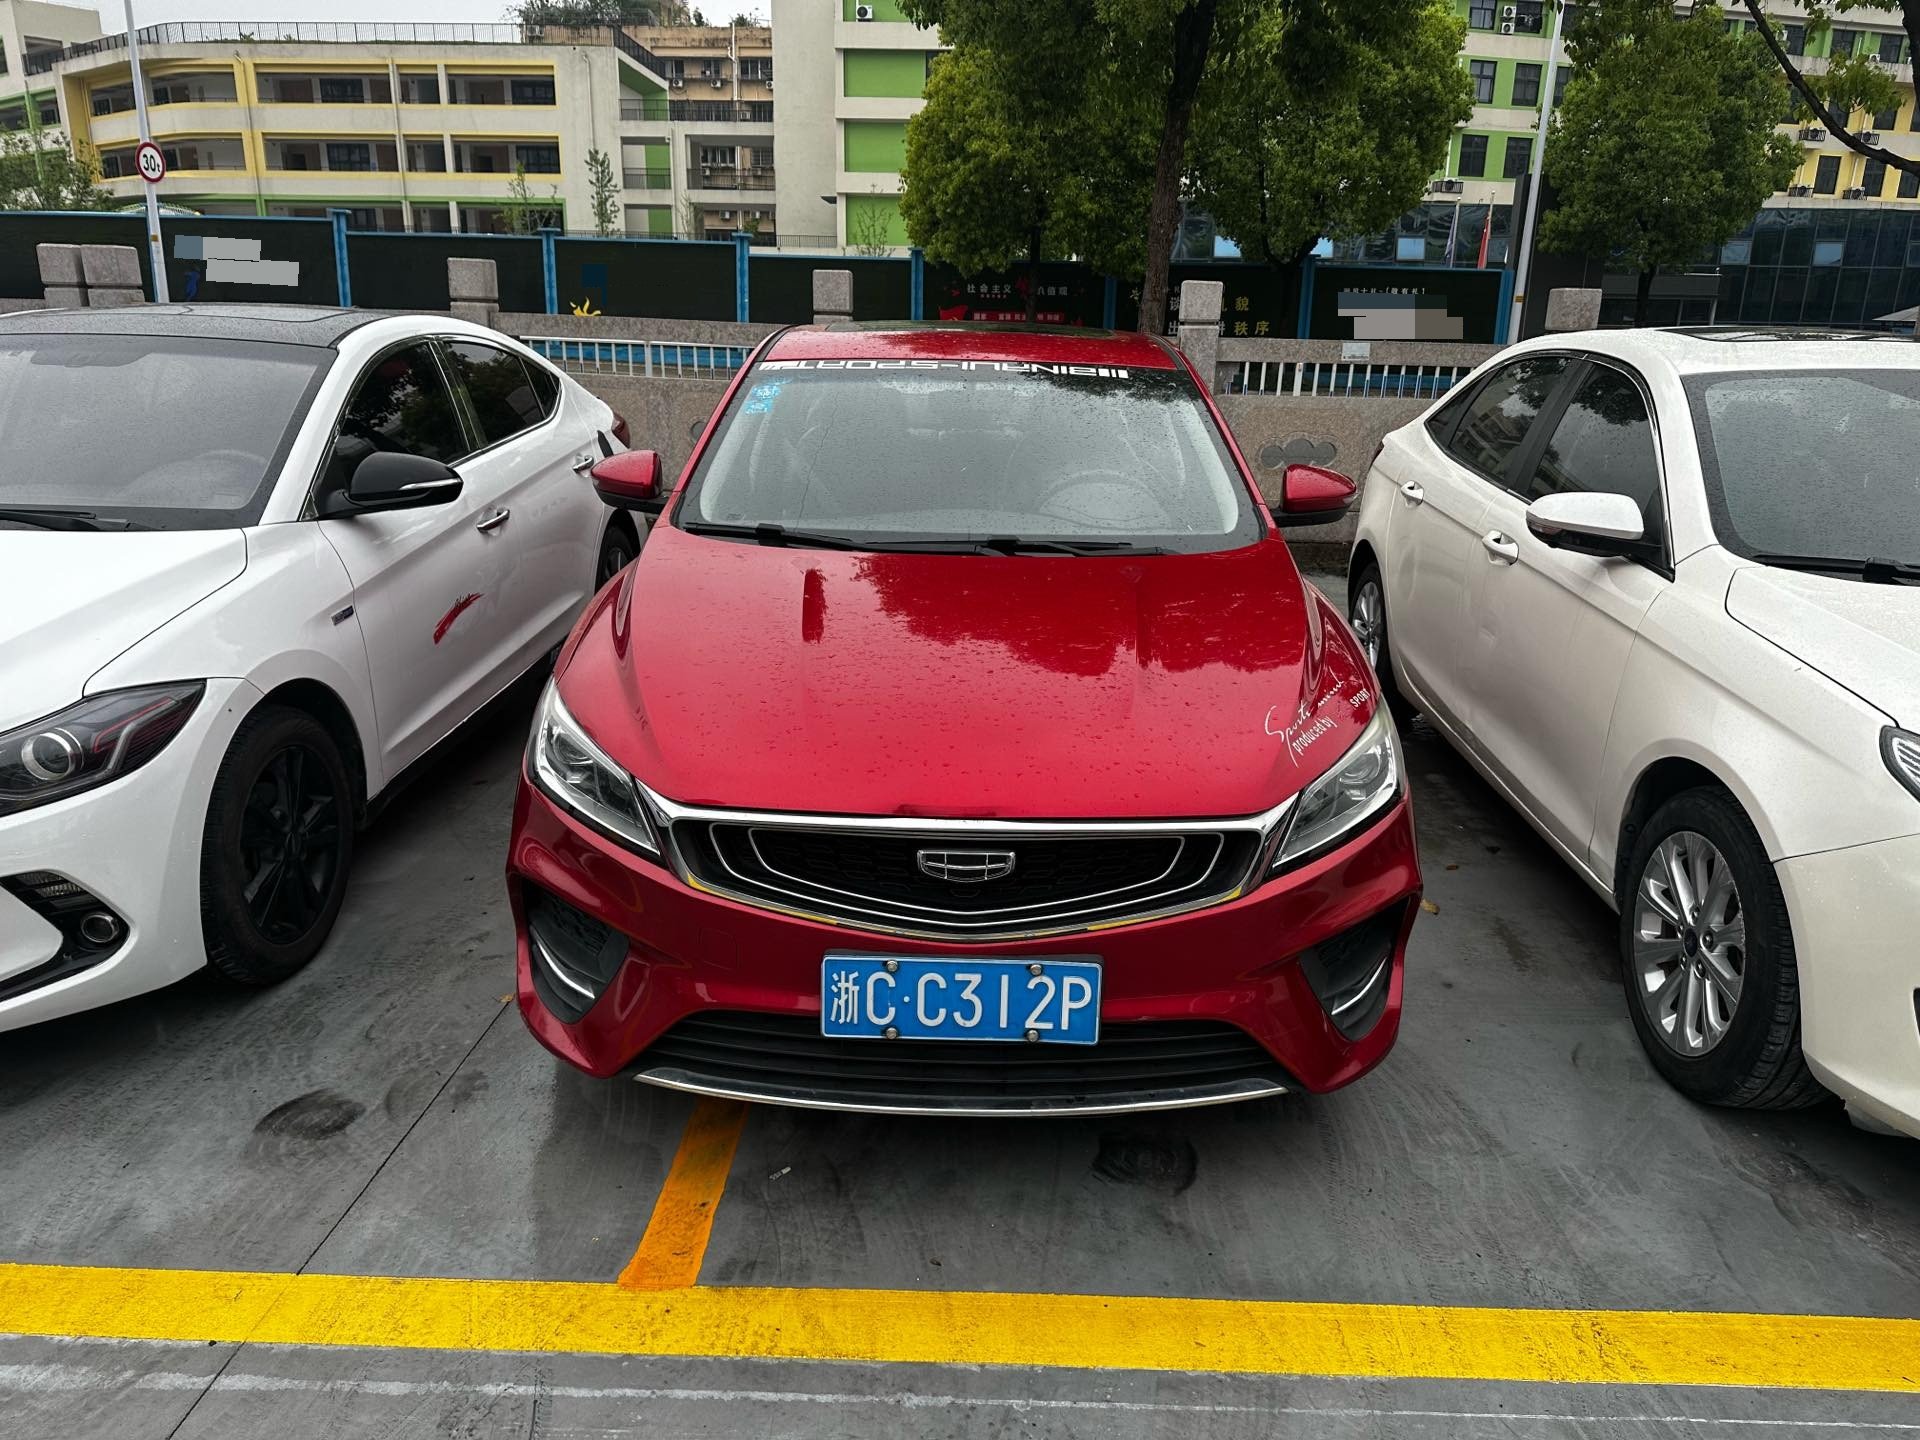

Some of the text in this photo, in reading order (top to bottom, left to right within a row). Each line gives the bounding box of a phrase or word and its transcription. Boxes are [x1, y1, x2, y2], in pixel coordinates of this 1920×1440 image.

[966, 283, 1012, 294] 社会主义
[1291, 688, 1371, 756] produced by SPORT
[830, 970, 1093, 1031] 浙C·C312P
